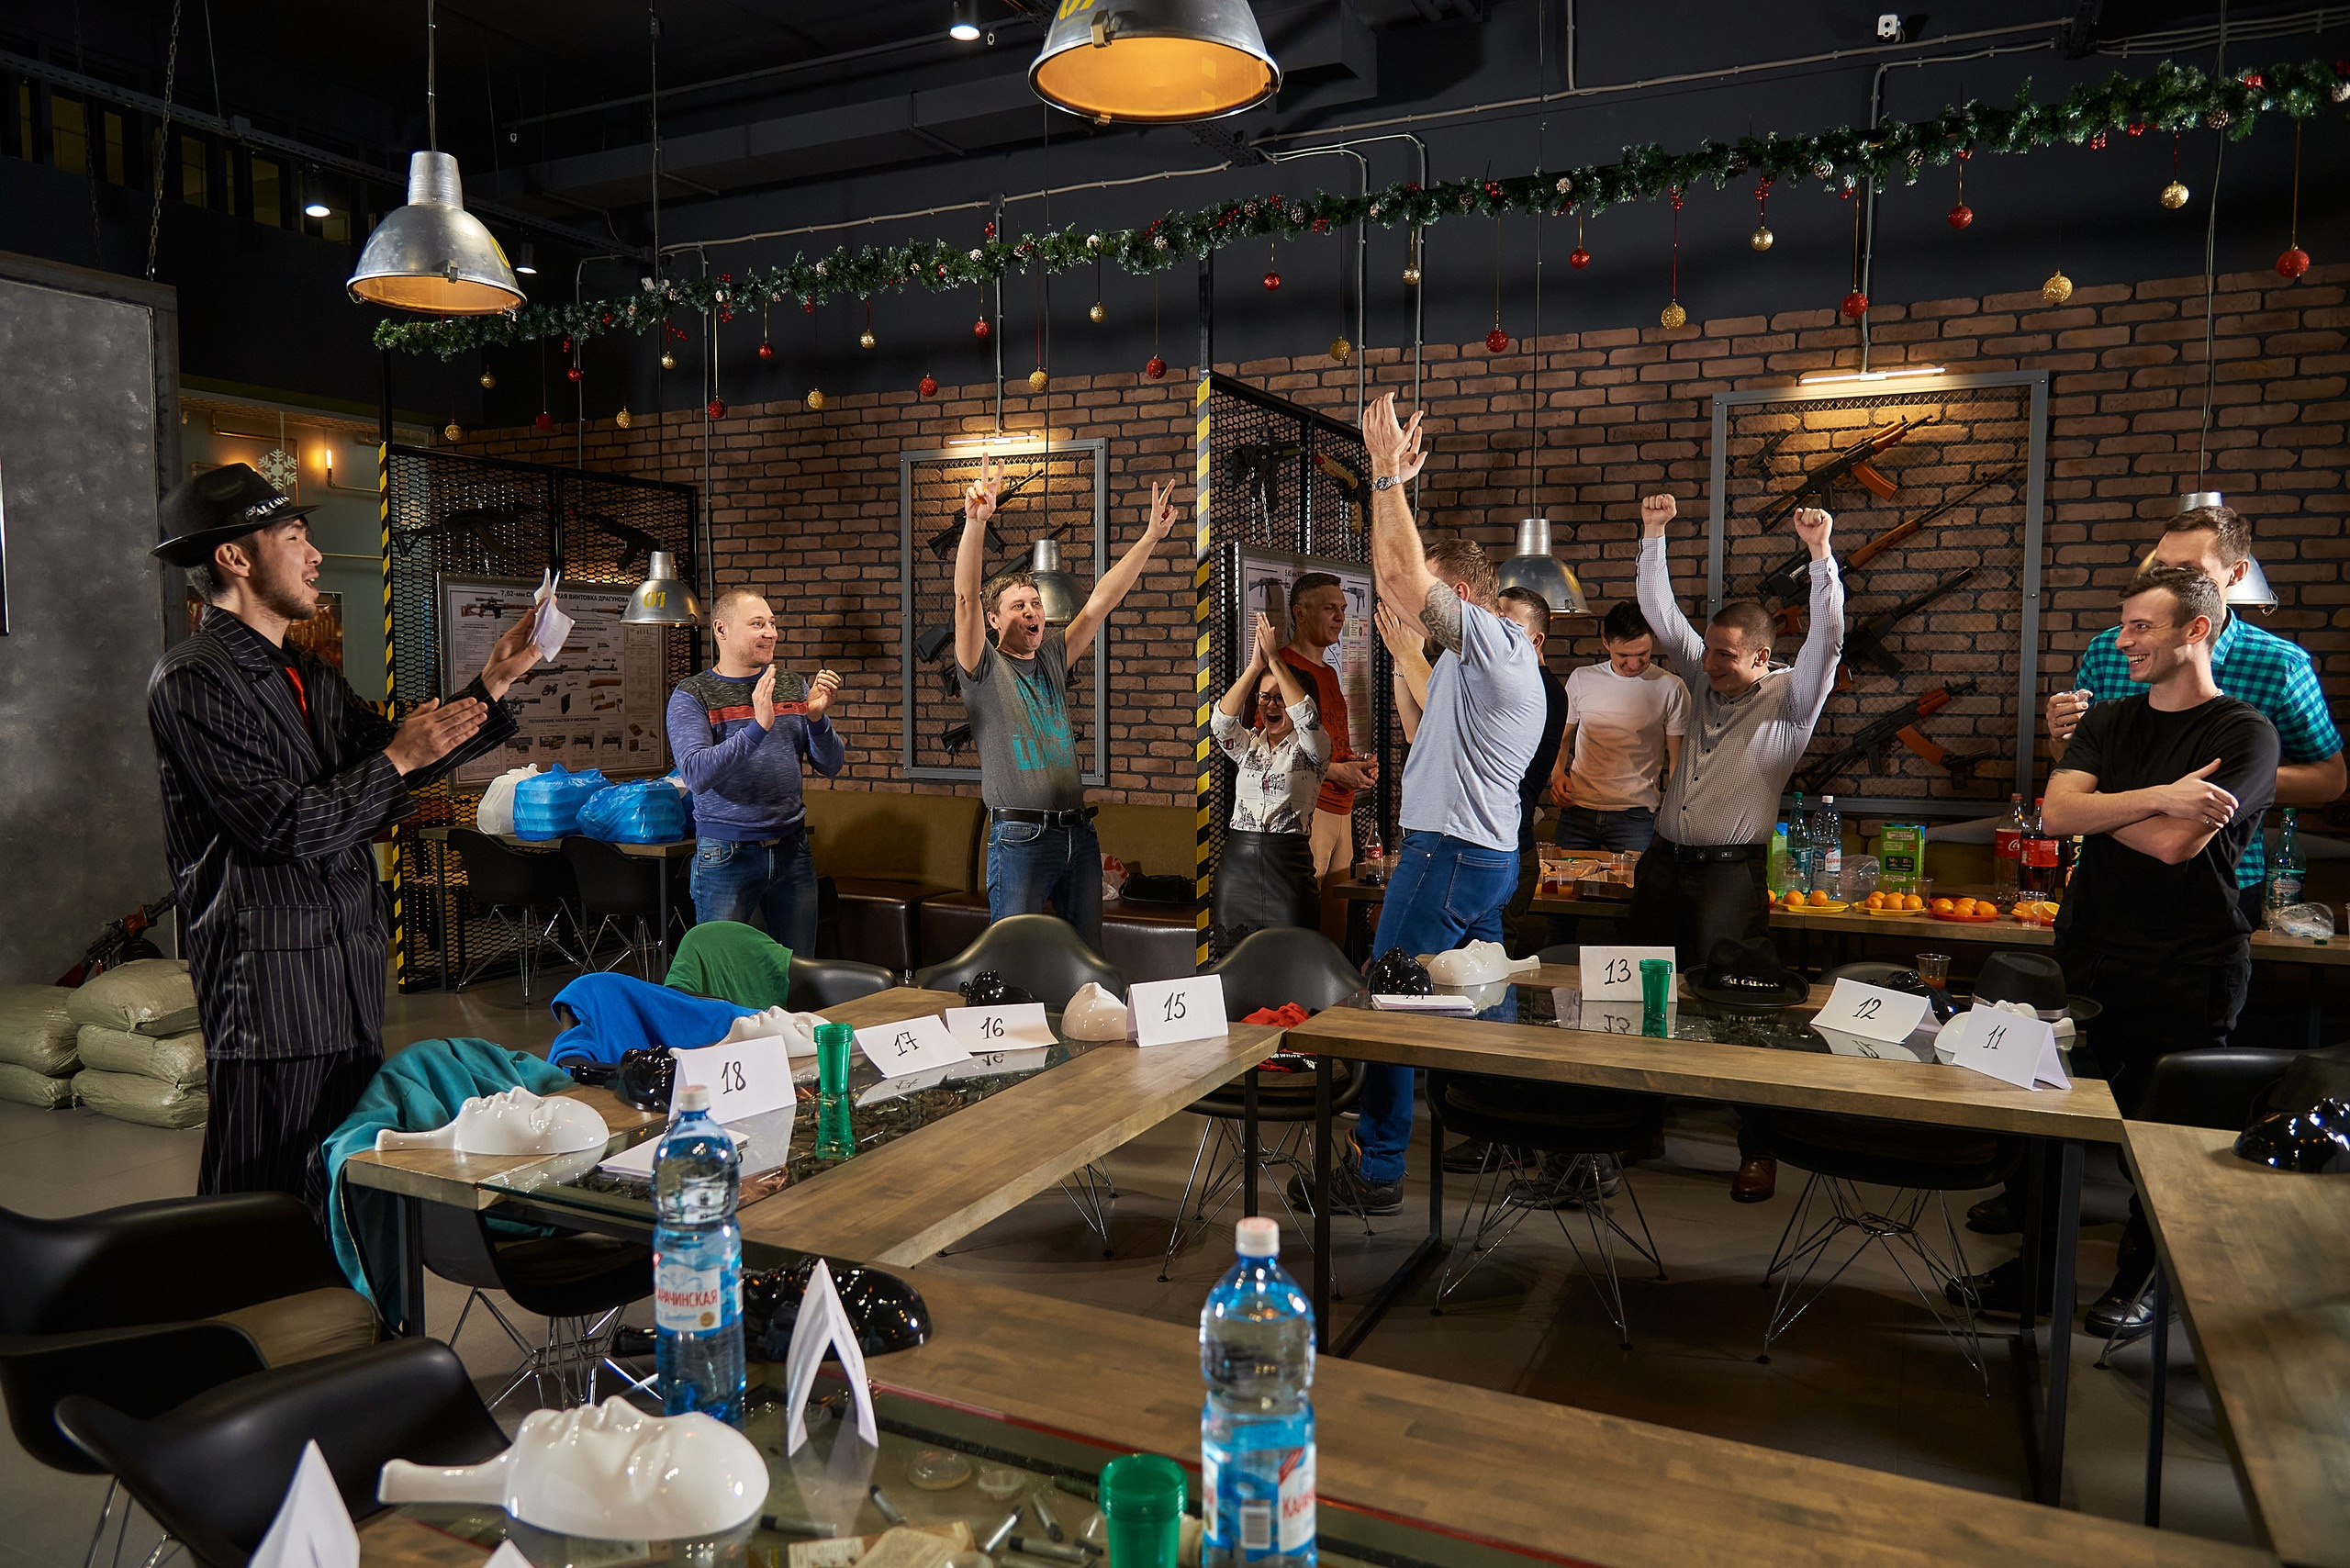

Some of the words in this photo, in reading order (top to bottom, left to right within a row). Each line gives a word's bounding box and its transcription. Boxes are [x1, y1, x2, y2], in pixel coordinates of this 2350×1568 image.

[569, 593, 598, 601] ВИНТОВКА
[598, 595, 629, 603] ДРАГУНОВА
[1604, 958, 1632, 986] 13
[1163, 991, 1186, 1022] 15
[1852, 997, 1882, 1019] 12
[979, 1016, 1005, 1039] 16
[1982, 1025, 2008, 1049] 11
[893, 1031, 920, 1057] 17
[721, 1060, 746, 1095] 18
